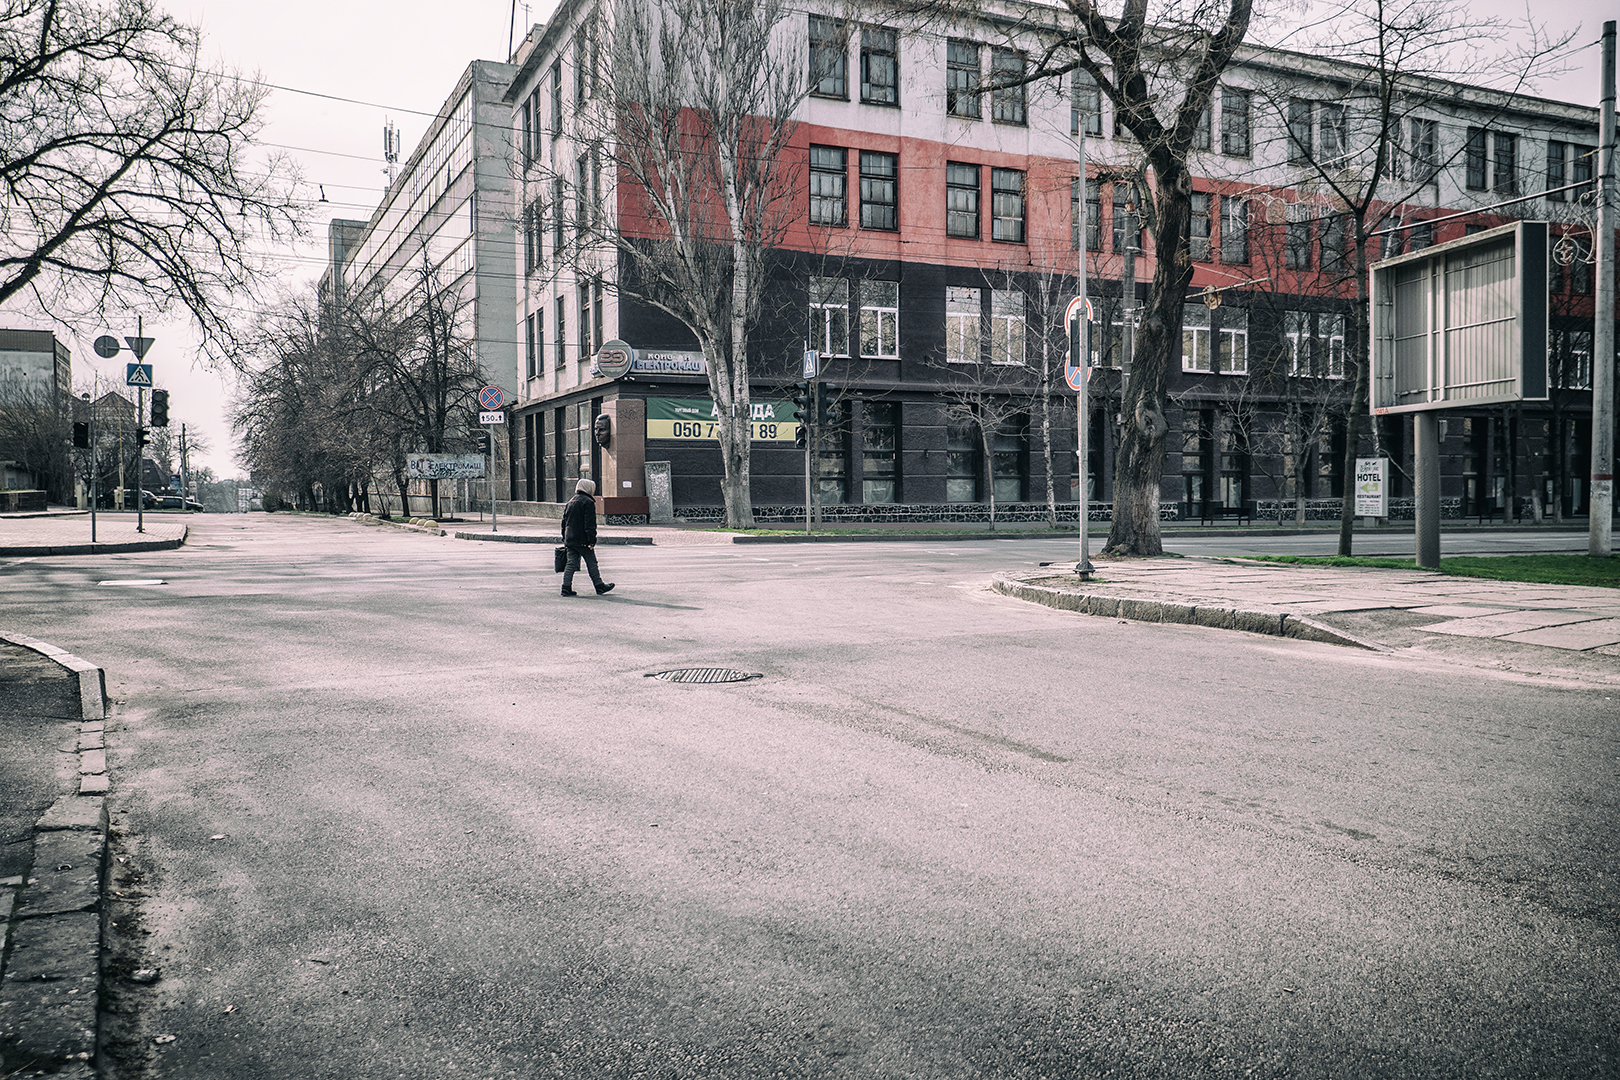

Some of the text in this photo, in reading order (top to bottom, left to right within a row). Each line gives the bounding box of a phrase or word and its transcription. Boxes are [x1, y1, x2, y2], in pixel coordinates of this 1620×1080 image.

[710, 403, 775, 420] АДА
[673, 422, 701, 438] 050
[759, 424, 777, 439] 89
[1356, 473, 1381, 482] HOTEL
